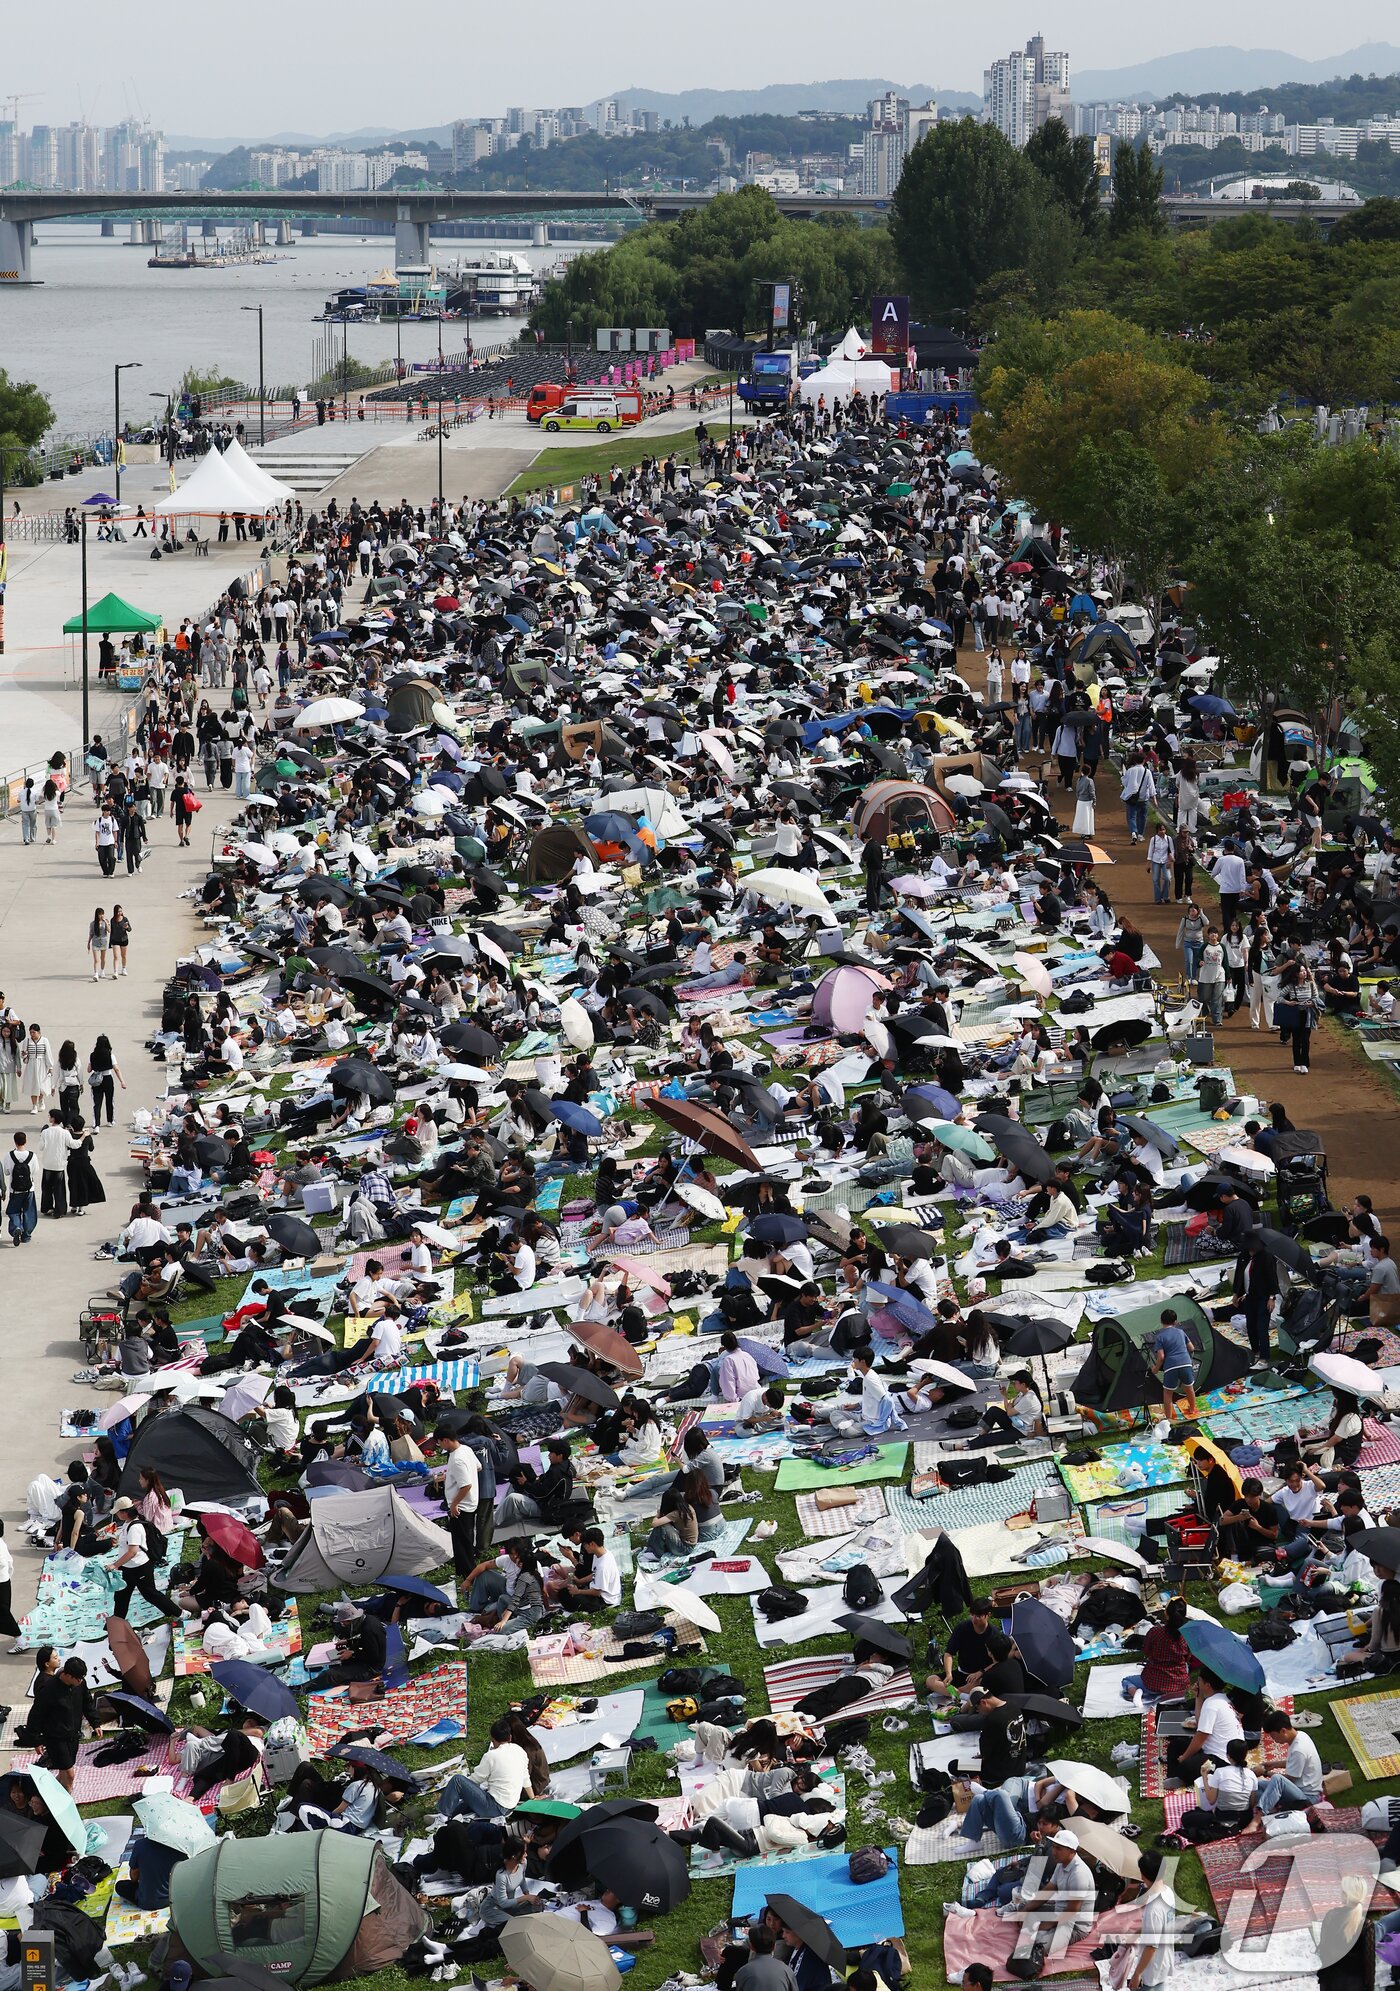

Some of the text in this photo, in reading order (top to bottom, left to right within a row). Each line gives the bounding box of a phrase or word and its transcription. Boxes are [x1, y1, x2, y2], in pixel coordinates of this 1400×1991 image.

[881, 302, 899, 322] A
[431, 917, 448, 927] NIKE
[1387, 1799, 1400, 1828] NIK
[270, 1961, 292, 1970] CAMP
